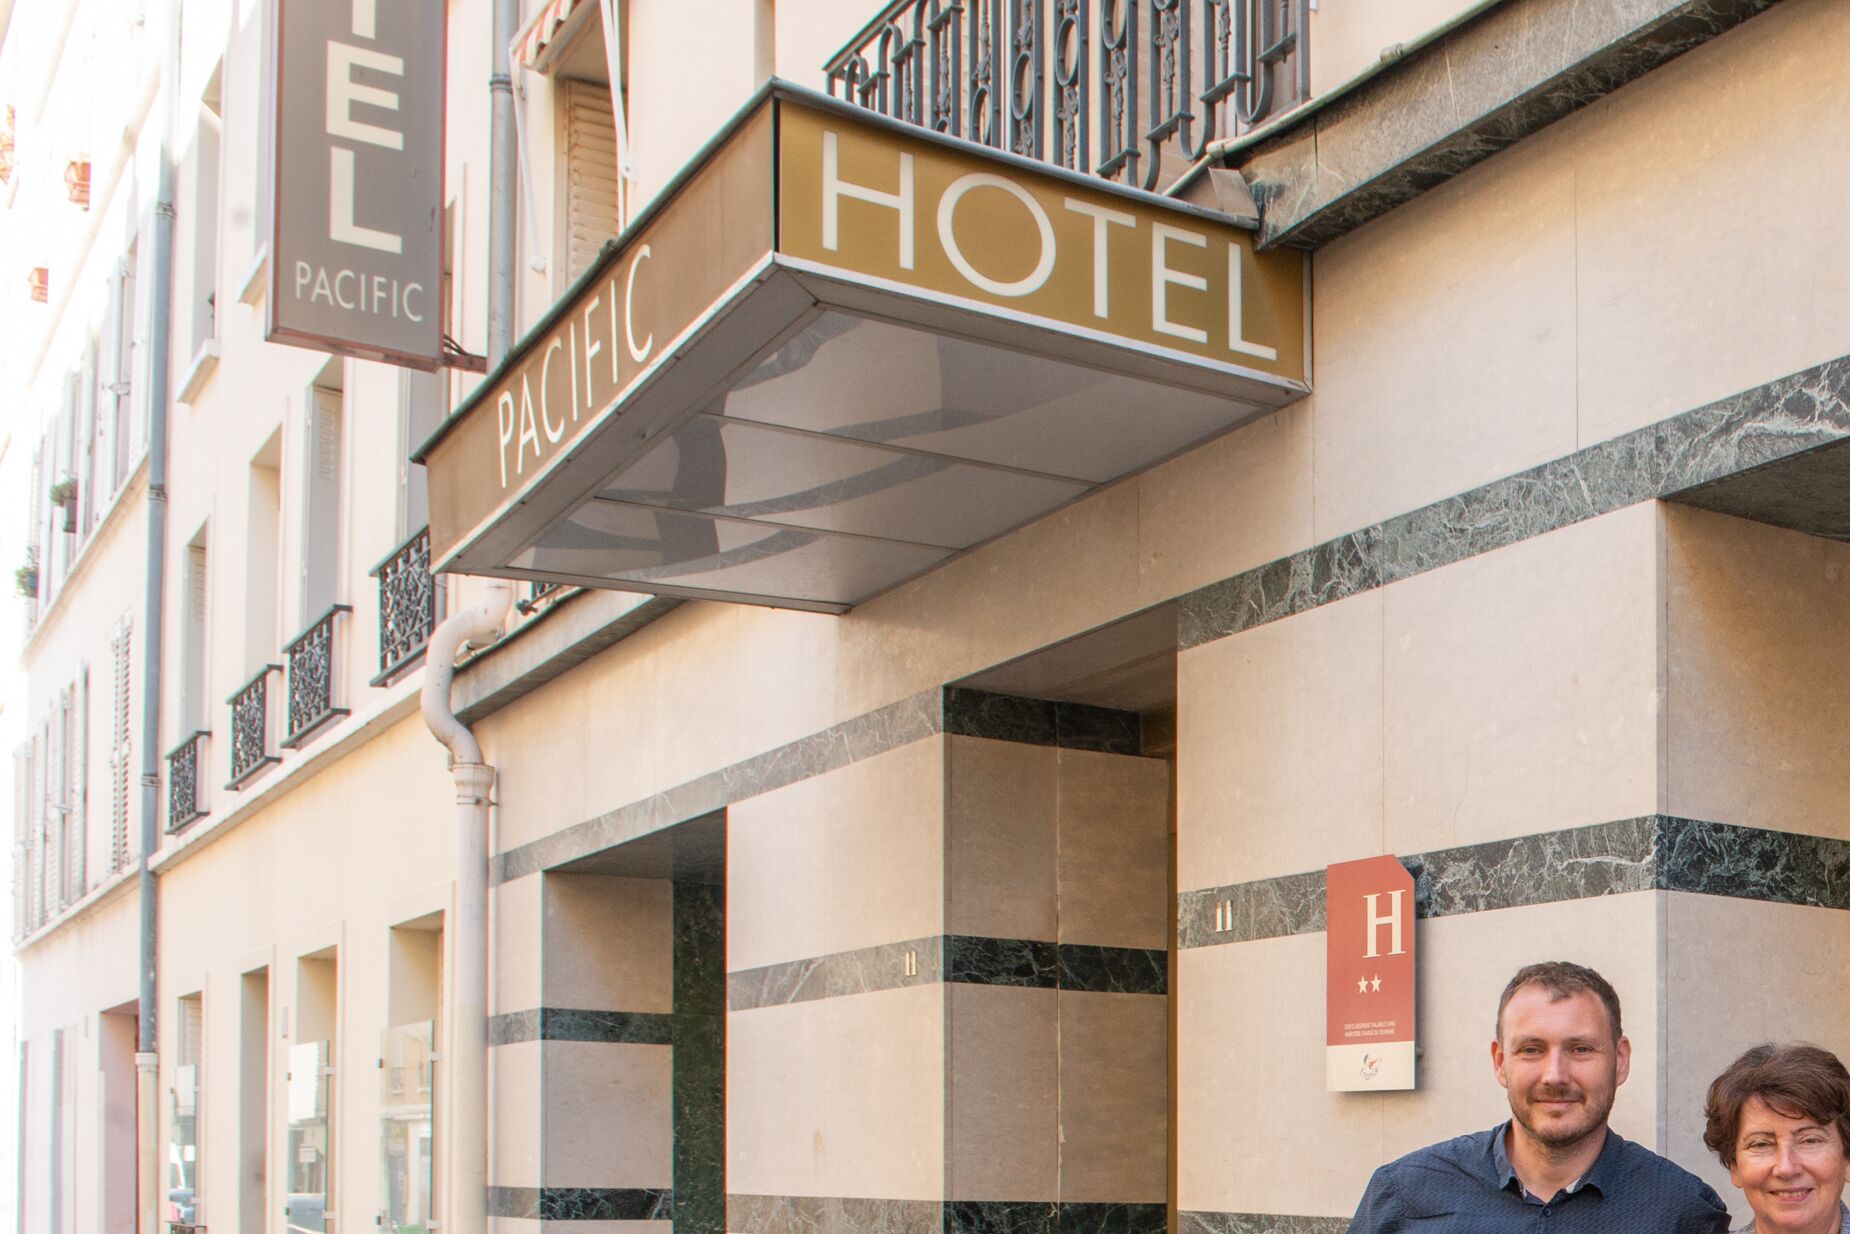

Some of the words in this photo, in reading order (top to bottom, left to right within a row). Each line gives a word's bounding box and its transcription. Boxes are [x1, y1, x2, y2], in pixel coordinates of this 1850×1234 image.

[296, 260, 424, 323] PACIFIC
[822, 130, 1277, 361] HOTEL
[498, 244, 653, 488] PACIFIC
[1363, 889, 1406, 959] H
